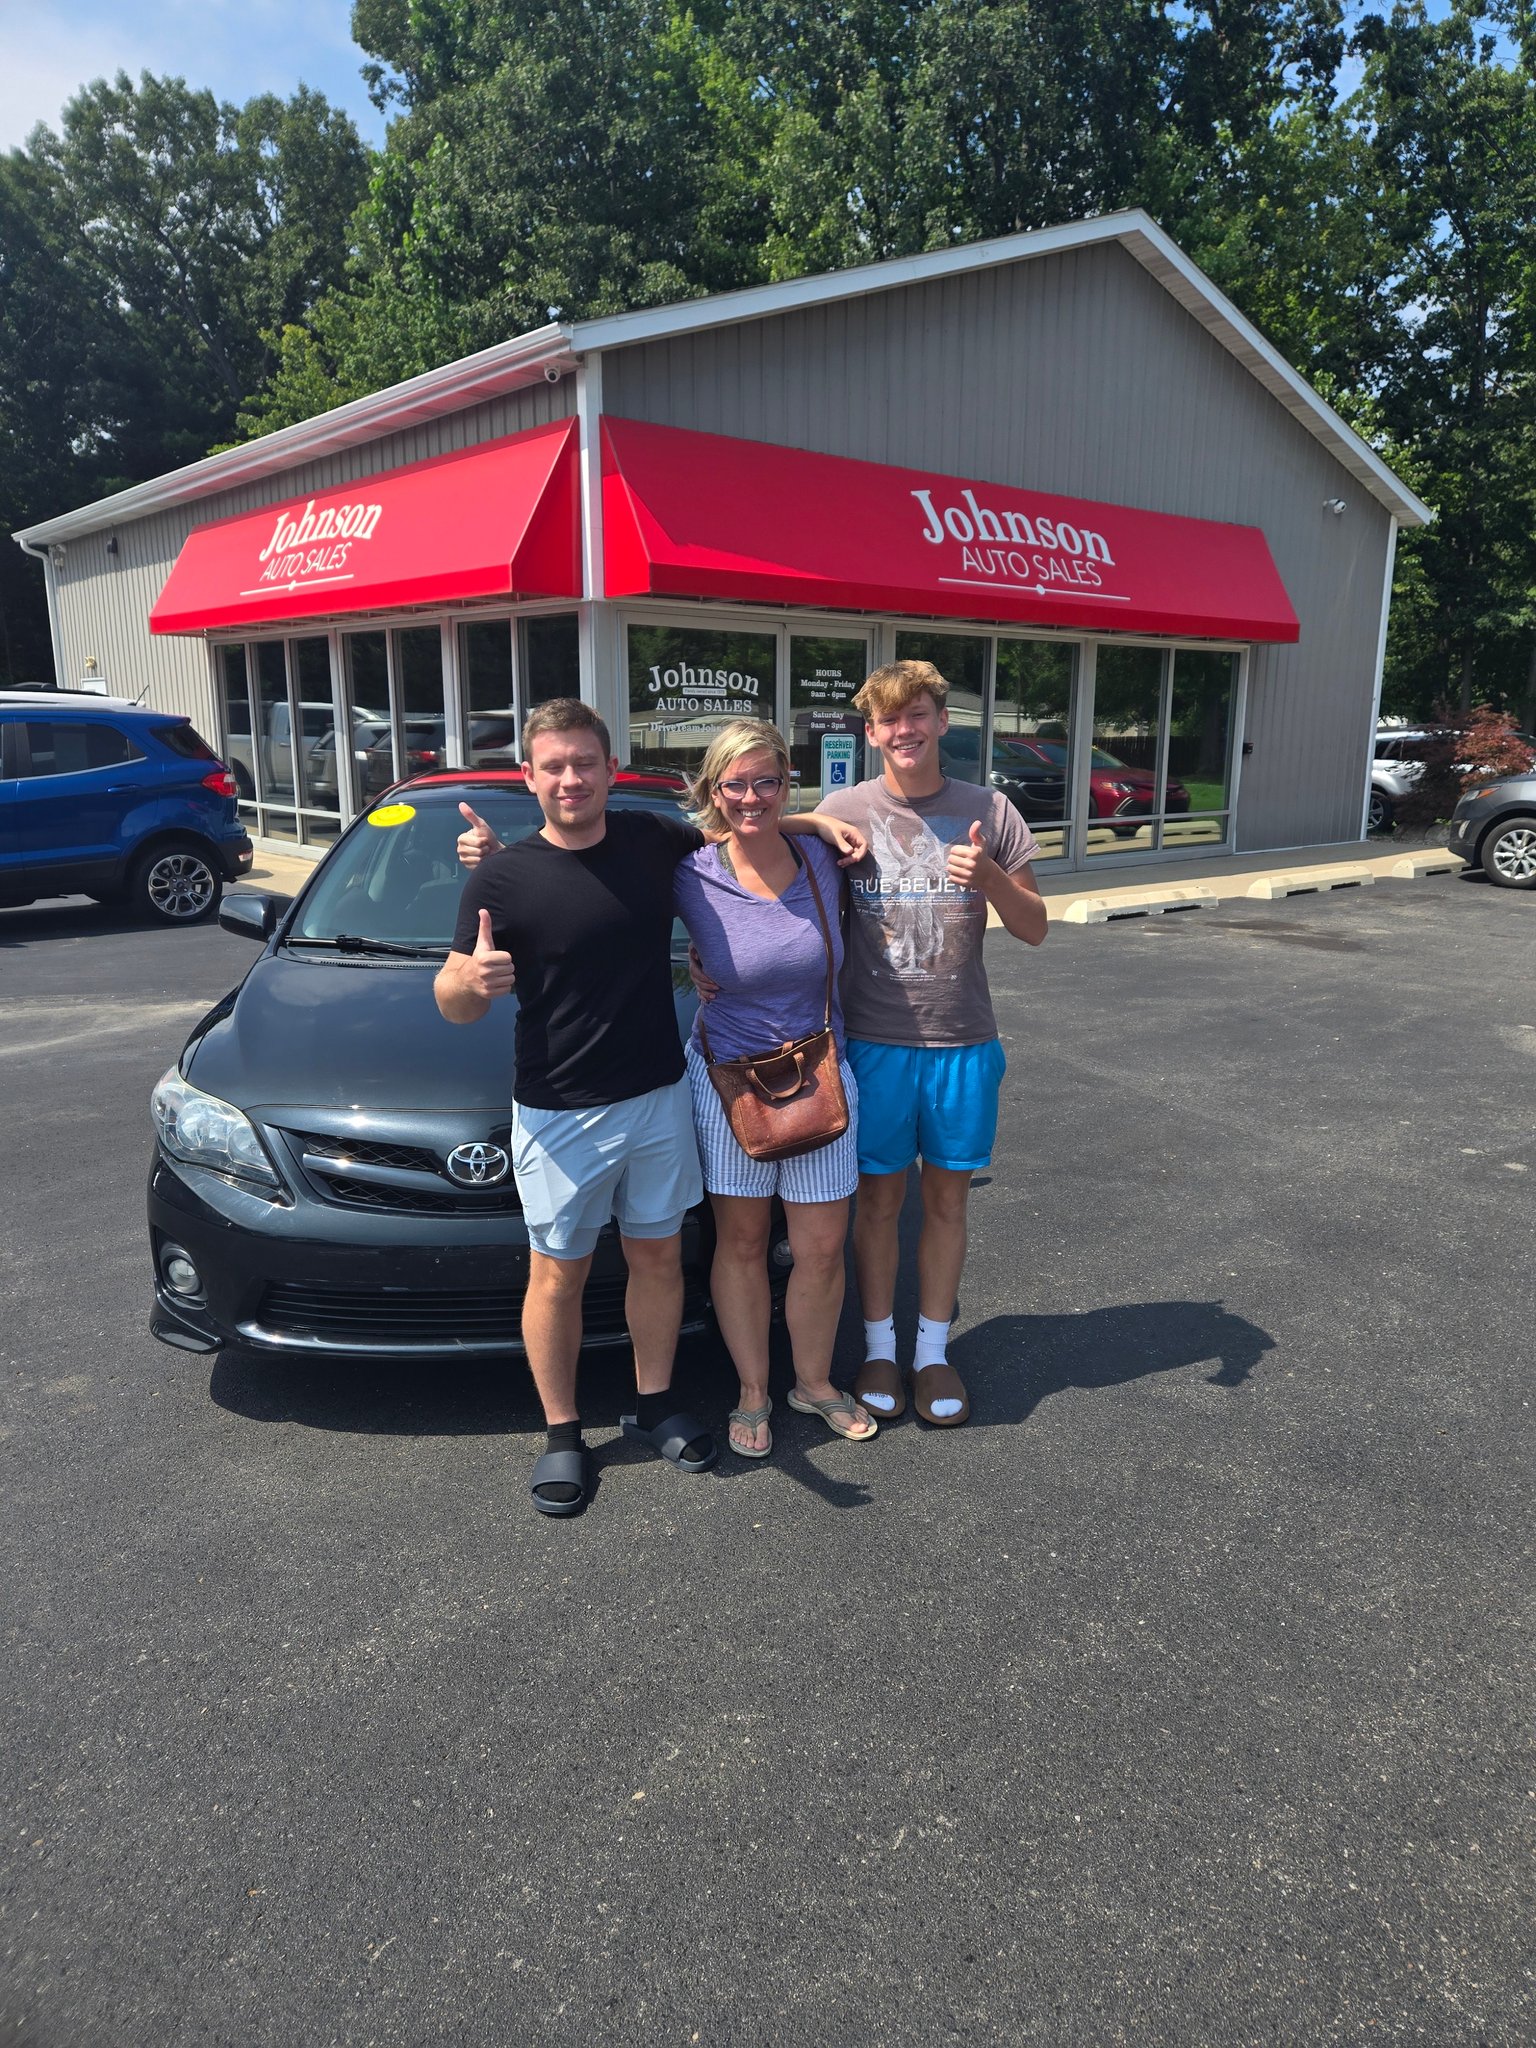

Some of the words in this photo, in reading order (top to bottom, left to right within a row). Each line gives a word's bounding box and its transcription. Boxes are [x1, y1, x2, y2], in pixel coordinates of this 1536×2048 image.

[259, 499, 382, 561] Johnson
[910, 489, 1115, 566] Johnson
[259, 551, 304, 582] AUTO
[300, 542, 352, 575] SALES
[962, 546, 1029, 577] AUTO
[1032, 555, 1102, 586] SALES
[648, 662, 759, 696] Johnson
[815, 669, 842, 677] HOURS
[800, 679, 828, 688] Monday
[834, 680, 856, 689] Friday
[831, 691, 846, 699] 6pm
[656, 697, 699, 711] AUTO
[703, 698, 752, 713] SALES
[812, 711, 844, 720] Saturday
[831, 722, 846, 730] 3pm
[824, 740, 853, 749] RESERVED
[827, 750, 850, 759] PARKING
[850, 878, 892, 893] RUE
